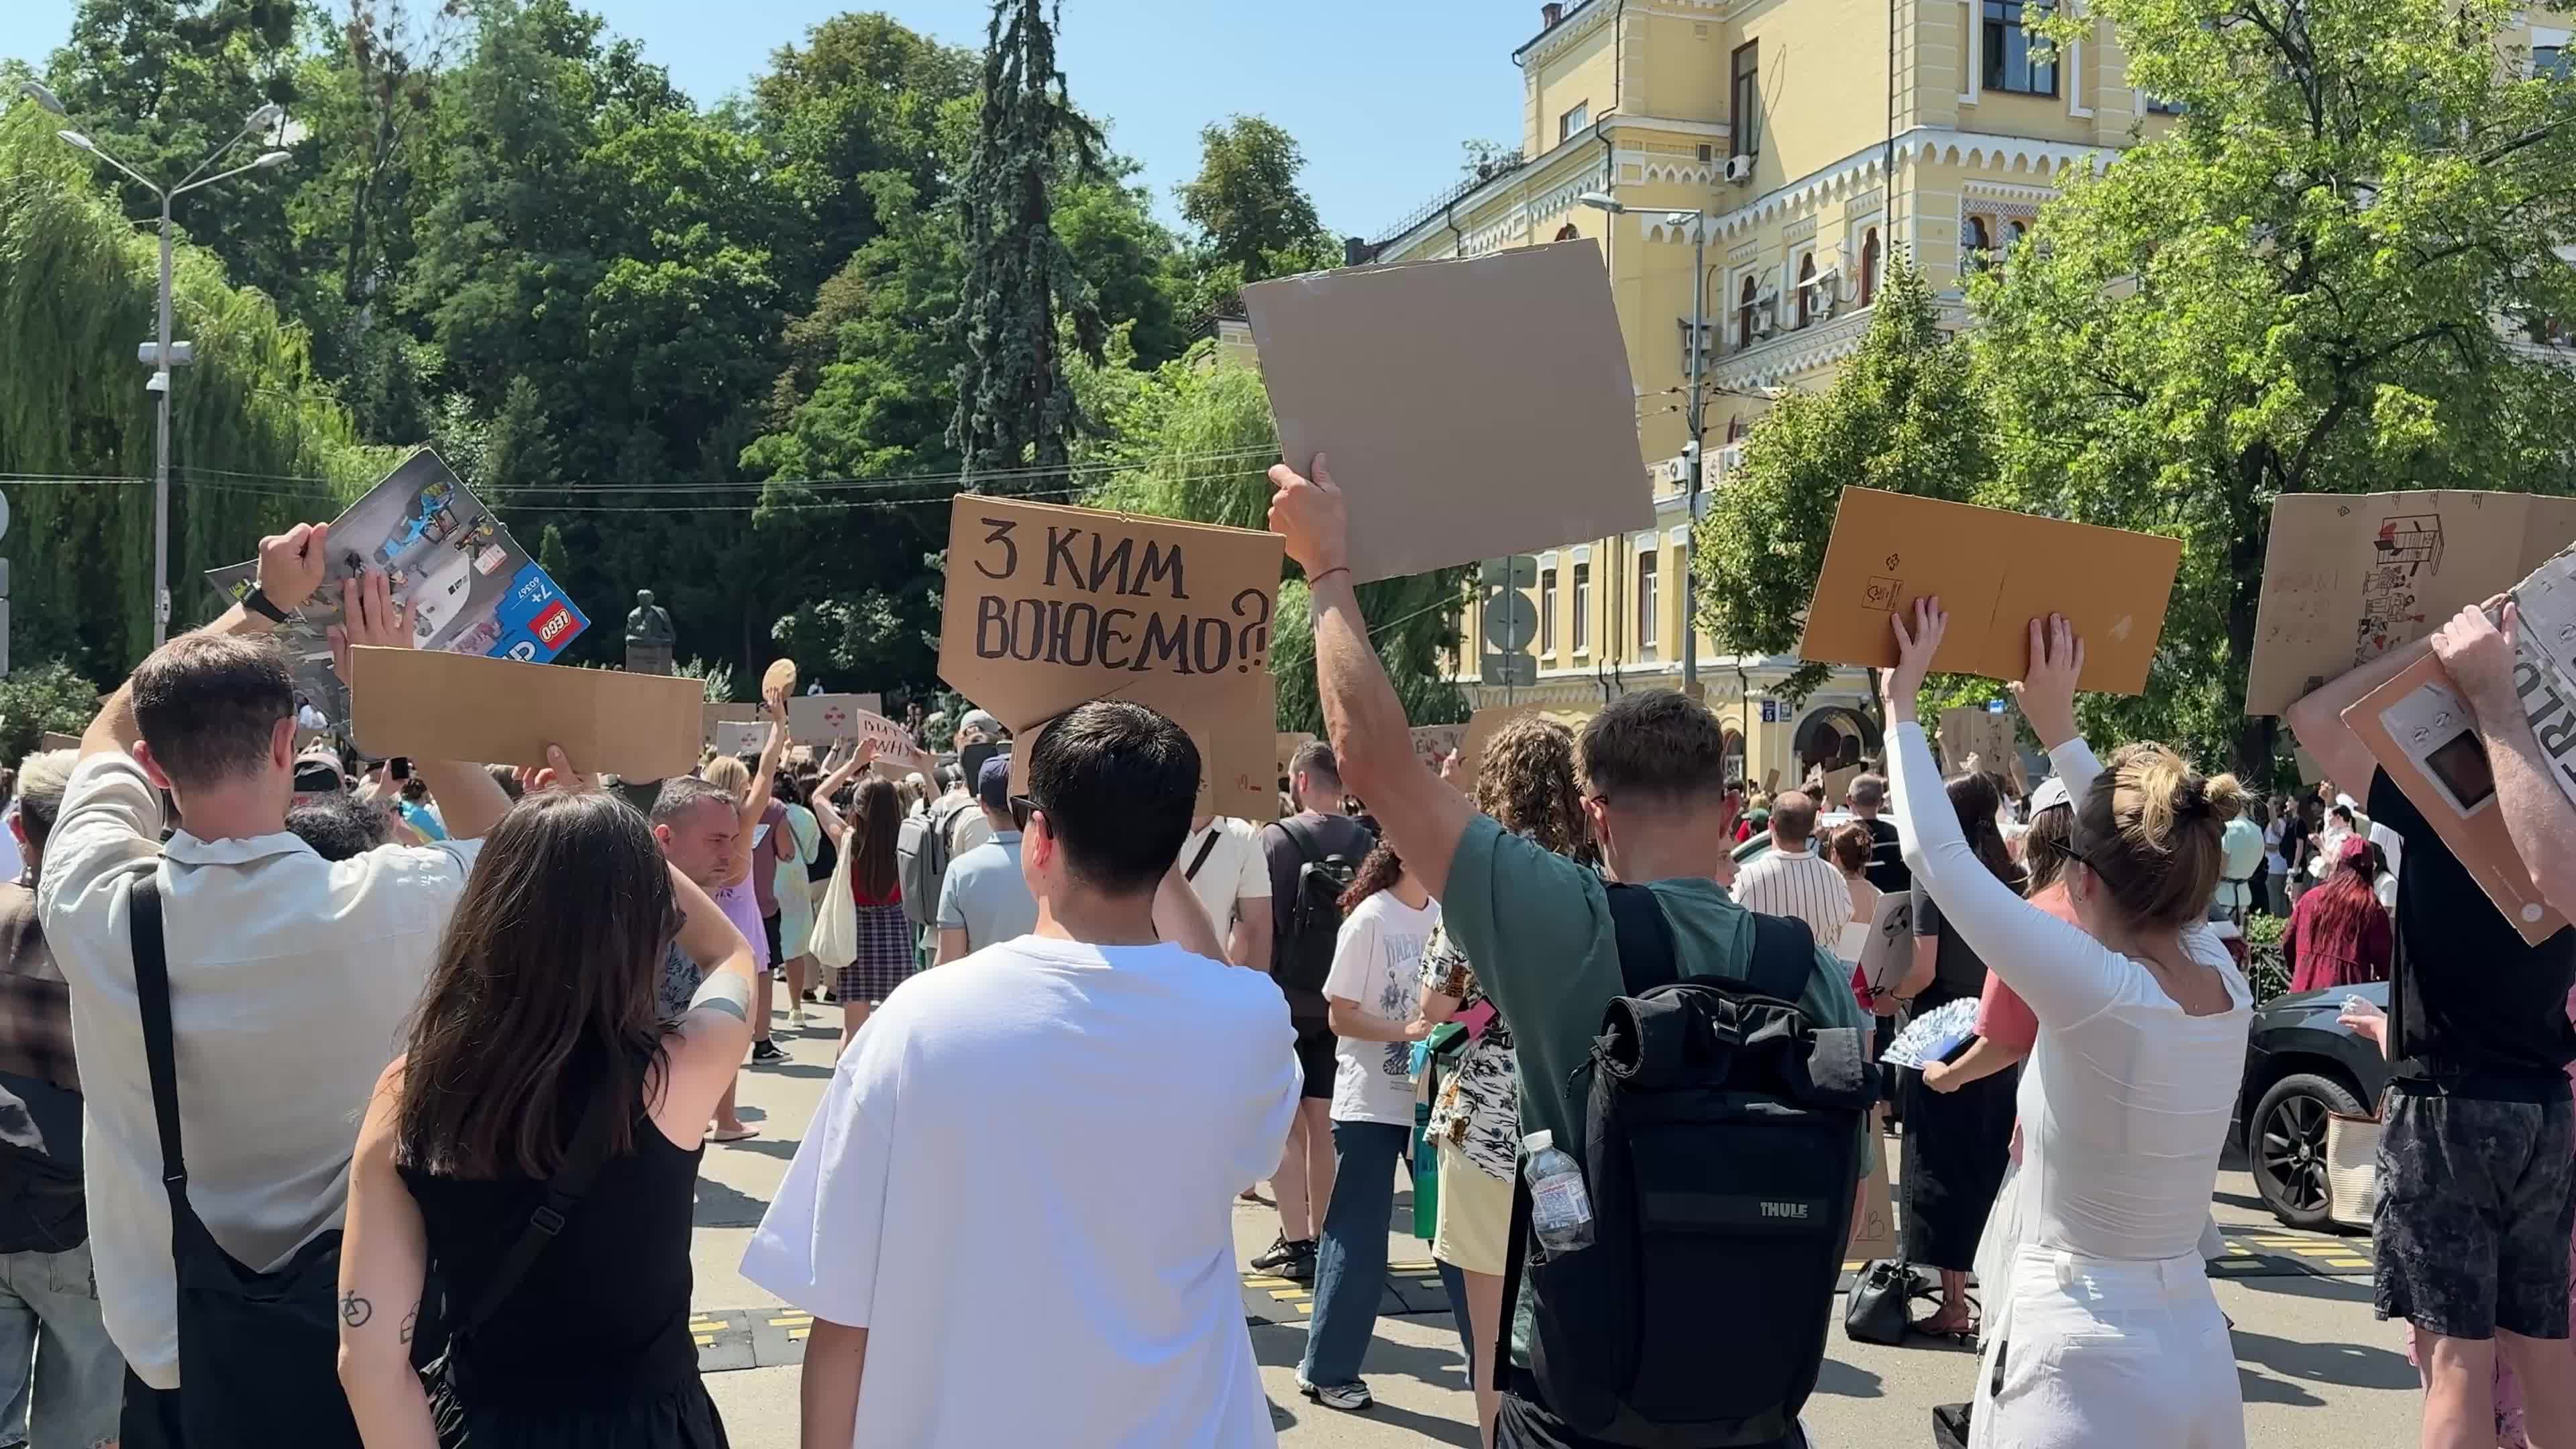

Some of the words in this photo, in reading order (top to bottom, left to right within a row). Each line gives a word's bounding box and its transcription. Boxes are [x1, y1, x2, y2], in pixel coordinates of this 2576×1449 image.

[974, 518, 1018, 580] З
[1042, 526, 1189, 599] КИМ
[518, 576, 540, 599] 60367
[531, 584, 552, 602] 7+
[539, 609, 571, 642] LEGO
[874, 740, 912, 757] WHY
[1760, 1201, 1808, 1218] THULE
